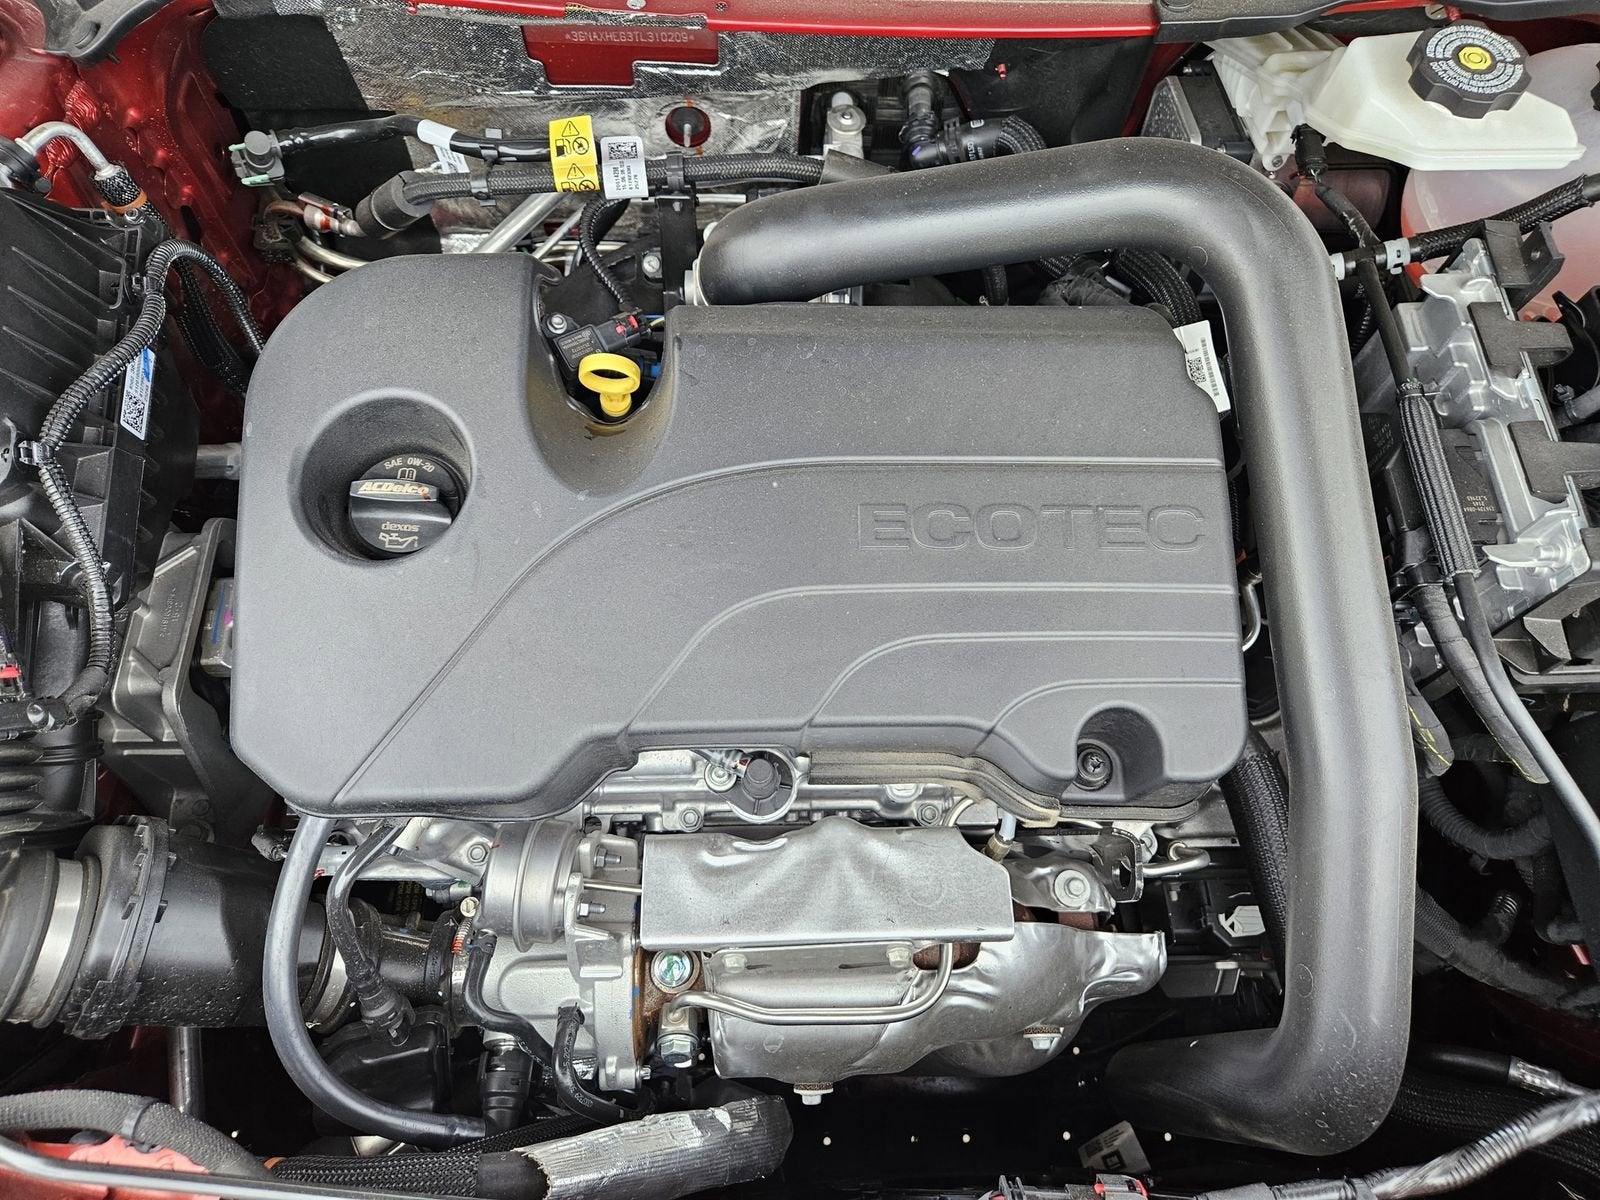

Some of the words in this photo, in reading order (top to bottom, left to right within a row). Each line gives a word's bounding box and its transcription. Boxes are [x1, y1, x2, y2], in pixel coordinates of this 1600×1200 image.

[384, 458, 403, 470] SAE
[407, 457, 435, 473] 0W-20
[358, 481, 430, 495] ACDelco
[381, 521, 420, 532] dexos
[857, 503, 1206, 552] ECOTEC
